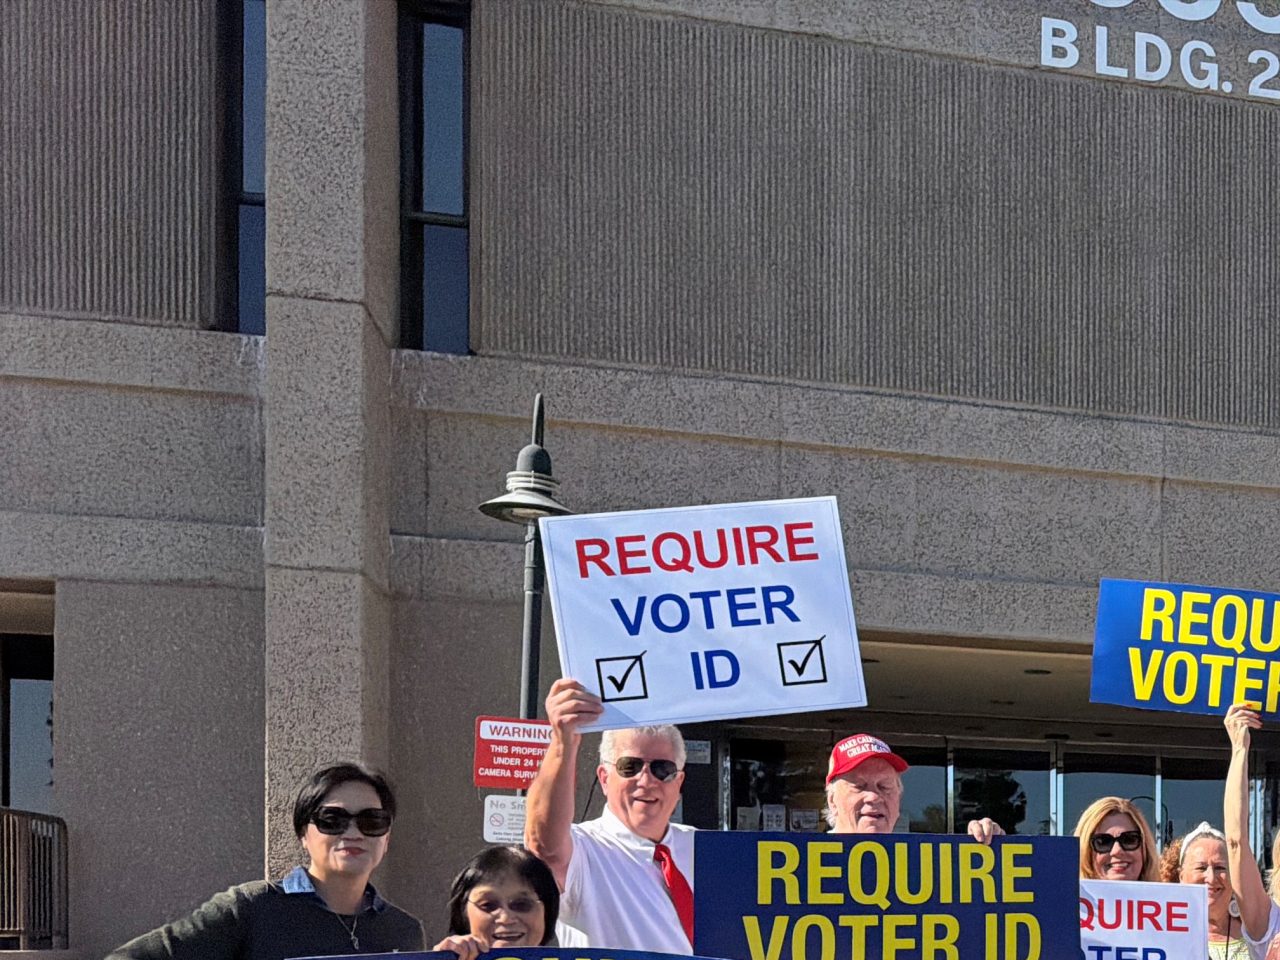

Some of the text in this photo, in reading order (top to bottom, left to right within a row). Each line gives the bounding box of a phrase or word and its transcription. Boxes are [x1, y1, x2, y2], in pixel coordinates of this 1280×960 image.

[1041, 17, 1233, 93] BLDG.
[1248, 50, 1280, 99] 2
[575, 522, 819, 579] REQUIRE
[611, 585, 801, 636] VOTER
[691, 650, 740, 690] ID
[478, 768, 511, 777] CAMERA
[490, 745, 547, 755] THIS PROPERT
[493, 757, 521, 766] UNDER
[524, 758, 533, 766] 24
[757, 840, 1034, 911] REQUIRE
